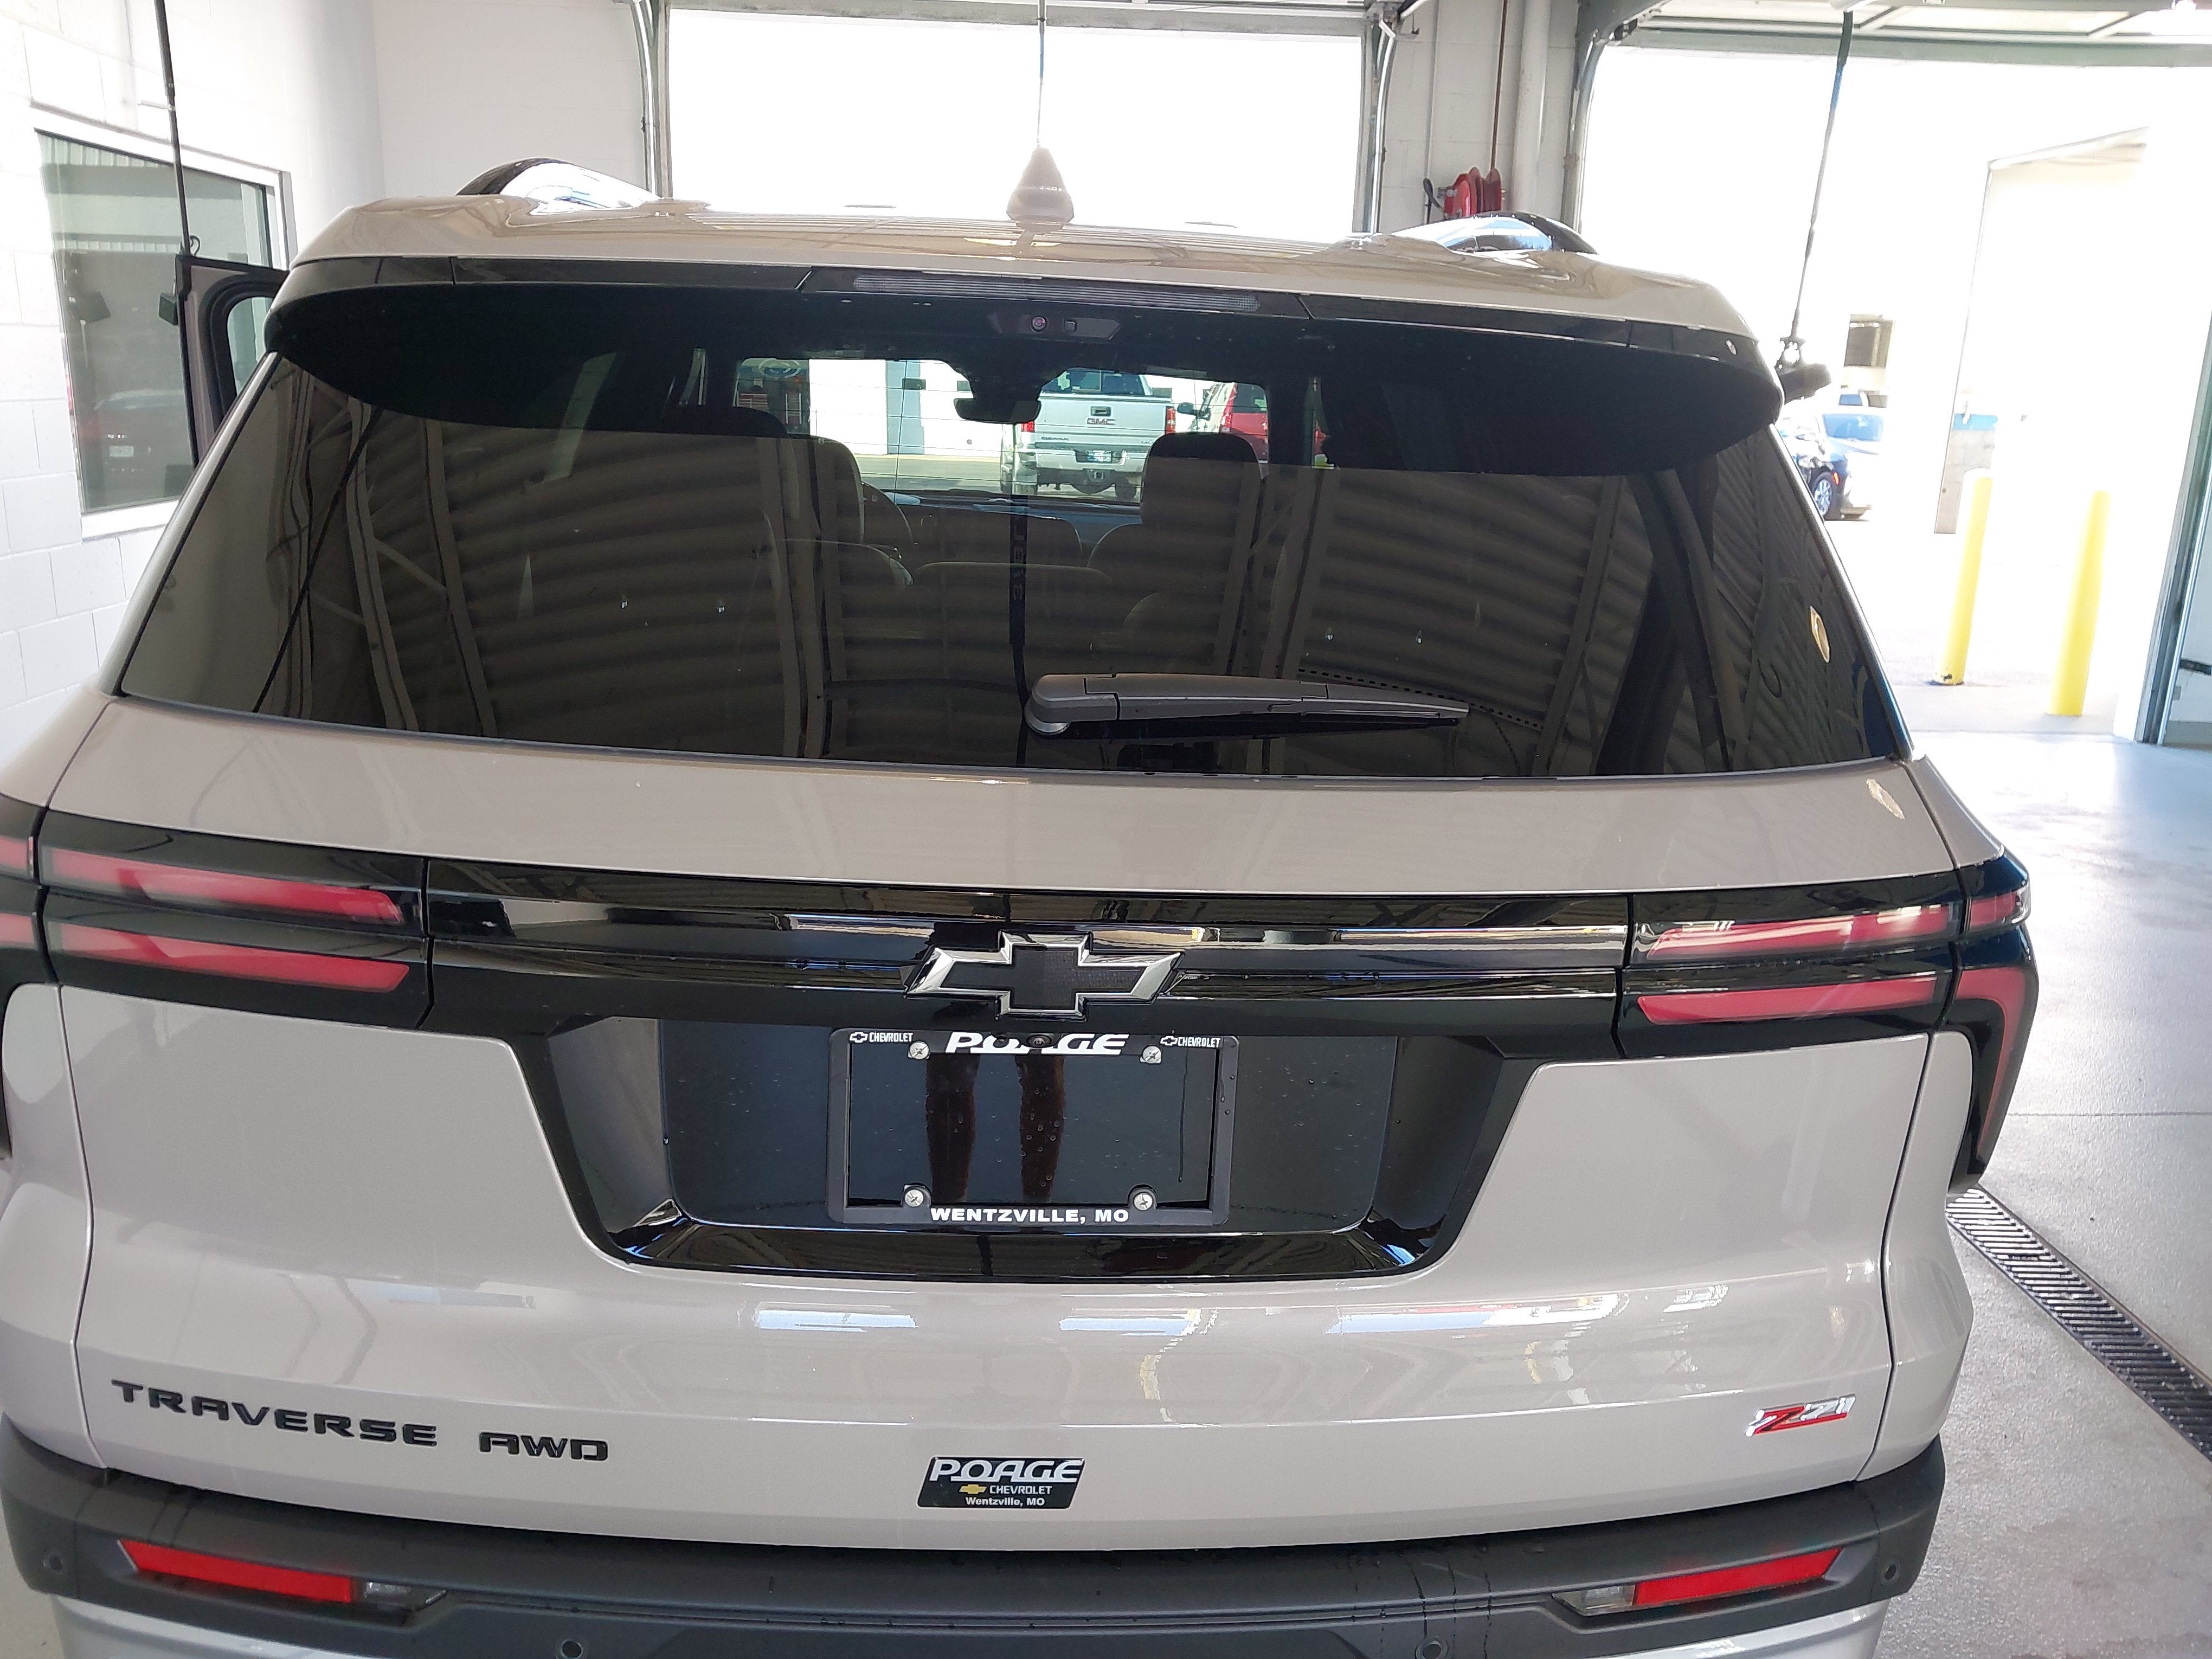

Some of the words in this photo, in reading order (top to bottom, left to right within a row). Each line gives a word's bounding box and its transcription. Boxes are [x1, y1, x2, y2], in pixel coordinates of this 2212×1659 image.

[1086, 417, 1116, 426] GMC
[869, 1032, 914, 1043] CHEVROLET
[945, 1032, 1130, 1055] POGE
[1178, 1037, 1221, 1048] CHEVROLET
[930, 1208, 1086, 1224] WENTZVILLE,
[1095, 1209, 1129, 1223] MO
[111, 1378, 438, 1447] TRAVERSE
[478, 1430, 609, 1462] AWD
[1745, 1393, 1856, 1437] Z71
[928, 1458, 1084, 1483] POAGE
[989, 1485, 1053, 1495] CHEVROLET
[964, 1496, 1024, 1507] Wentzville,
[1026, 1497, 1045, 1506] MO
